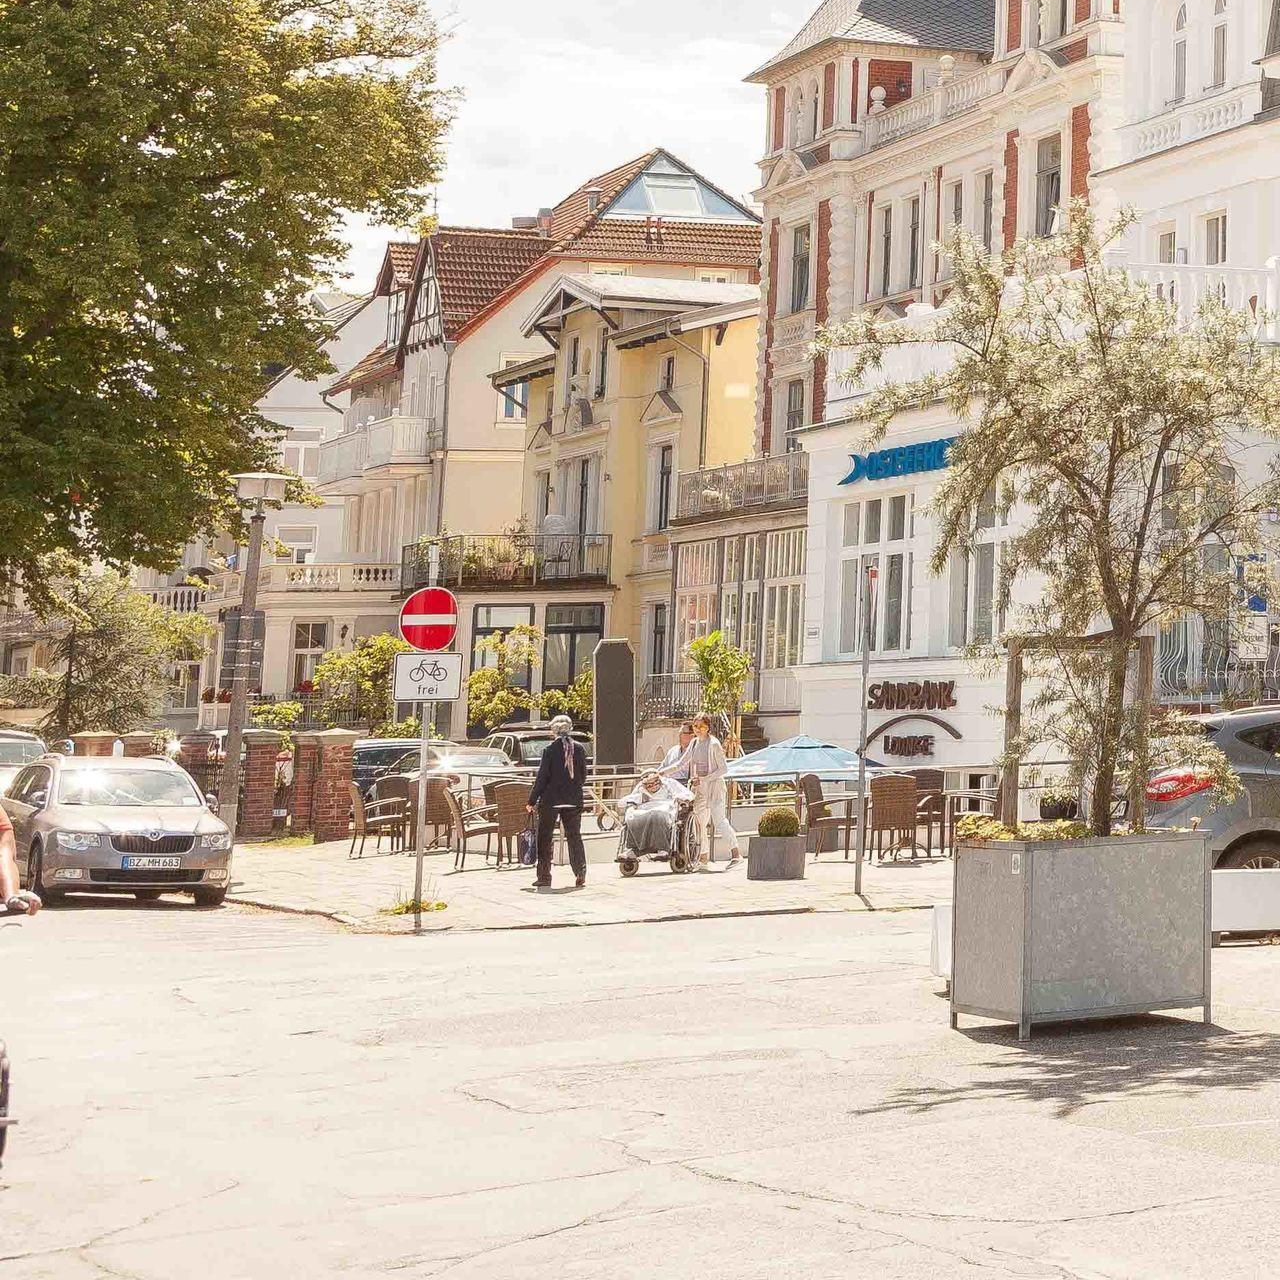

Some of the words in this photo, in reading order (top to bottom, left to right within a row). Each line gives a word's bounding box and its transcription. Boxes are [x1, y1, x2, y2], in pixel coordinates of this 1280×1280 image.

[418, 685, 438, 695] frei
[867, 680, 957, 710] SANDBANK
[129, 858, 142, 867] BZ
[147, 858, 161, 867] MH
[162, 858, 180, 867] 683
